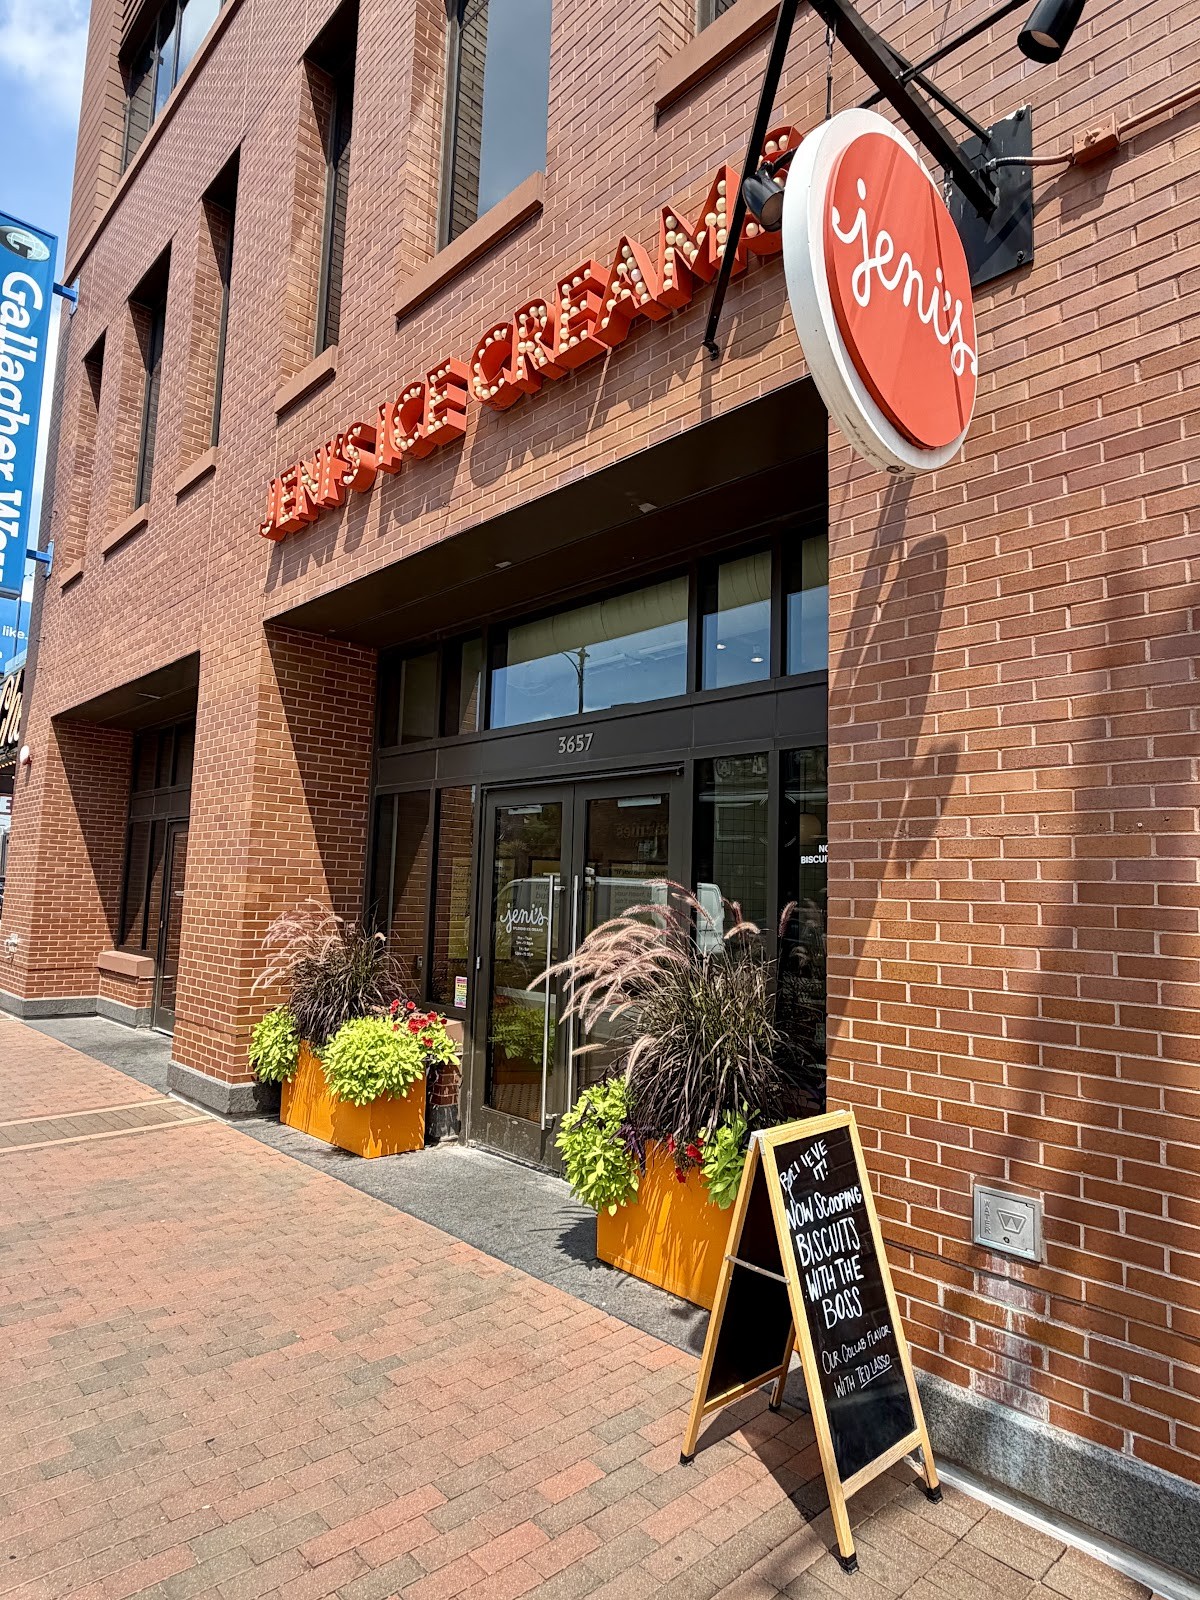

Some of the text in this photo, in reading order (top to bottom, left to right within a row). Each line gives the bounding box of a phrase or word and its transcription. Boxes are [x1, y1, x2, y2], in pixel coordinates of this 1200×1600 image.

[832, 178, 978, 377] jeni's
[375, 357, 471, 475] ICE
[558, 732, 594, 754] 3657
[800, 854, 829, 864] BISCUI
[500, 902, 549, 934] jeni's
[812, 1157, 829, 1181] IT!
[785, 1185, 862, 1231] NOW SCOOPING
[795, 1216, 861, 1267] BISCUITS
[805, 1254, 865, 1303] WITH THE
[822, 1286, 863, 1330] BOSS
[841, 1343, 867, 1363] COLLAB
[866, 1324, 892, 1348] FLAVOR
[833, 1353, 891, 1399] WITH TED LASSO
